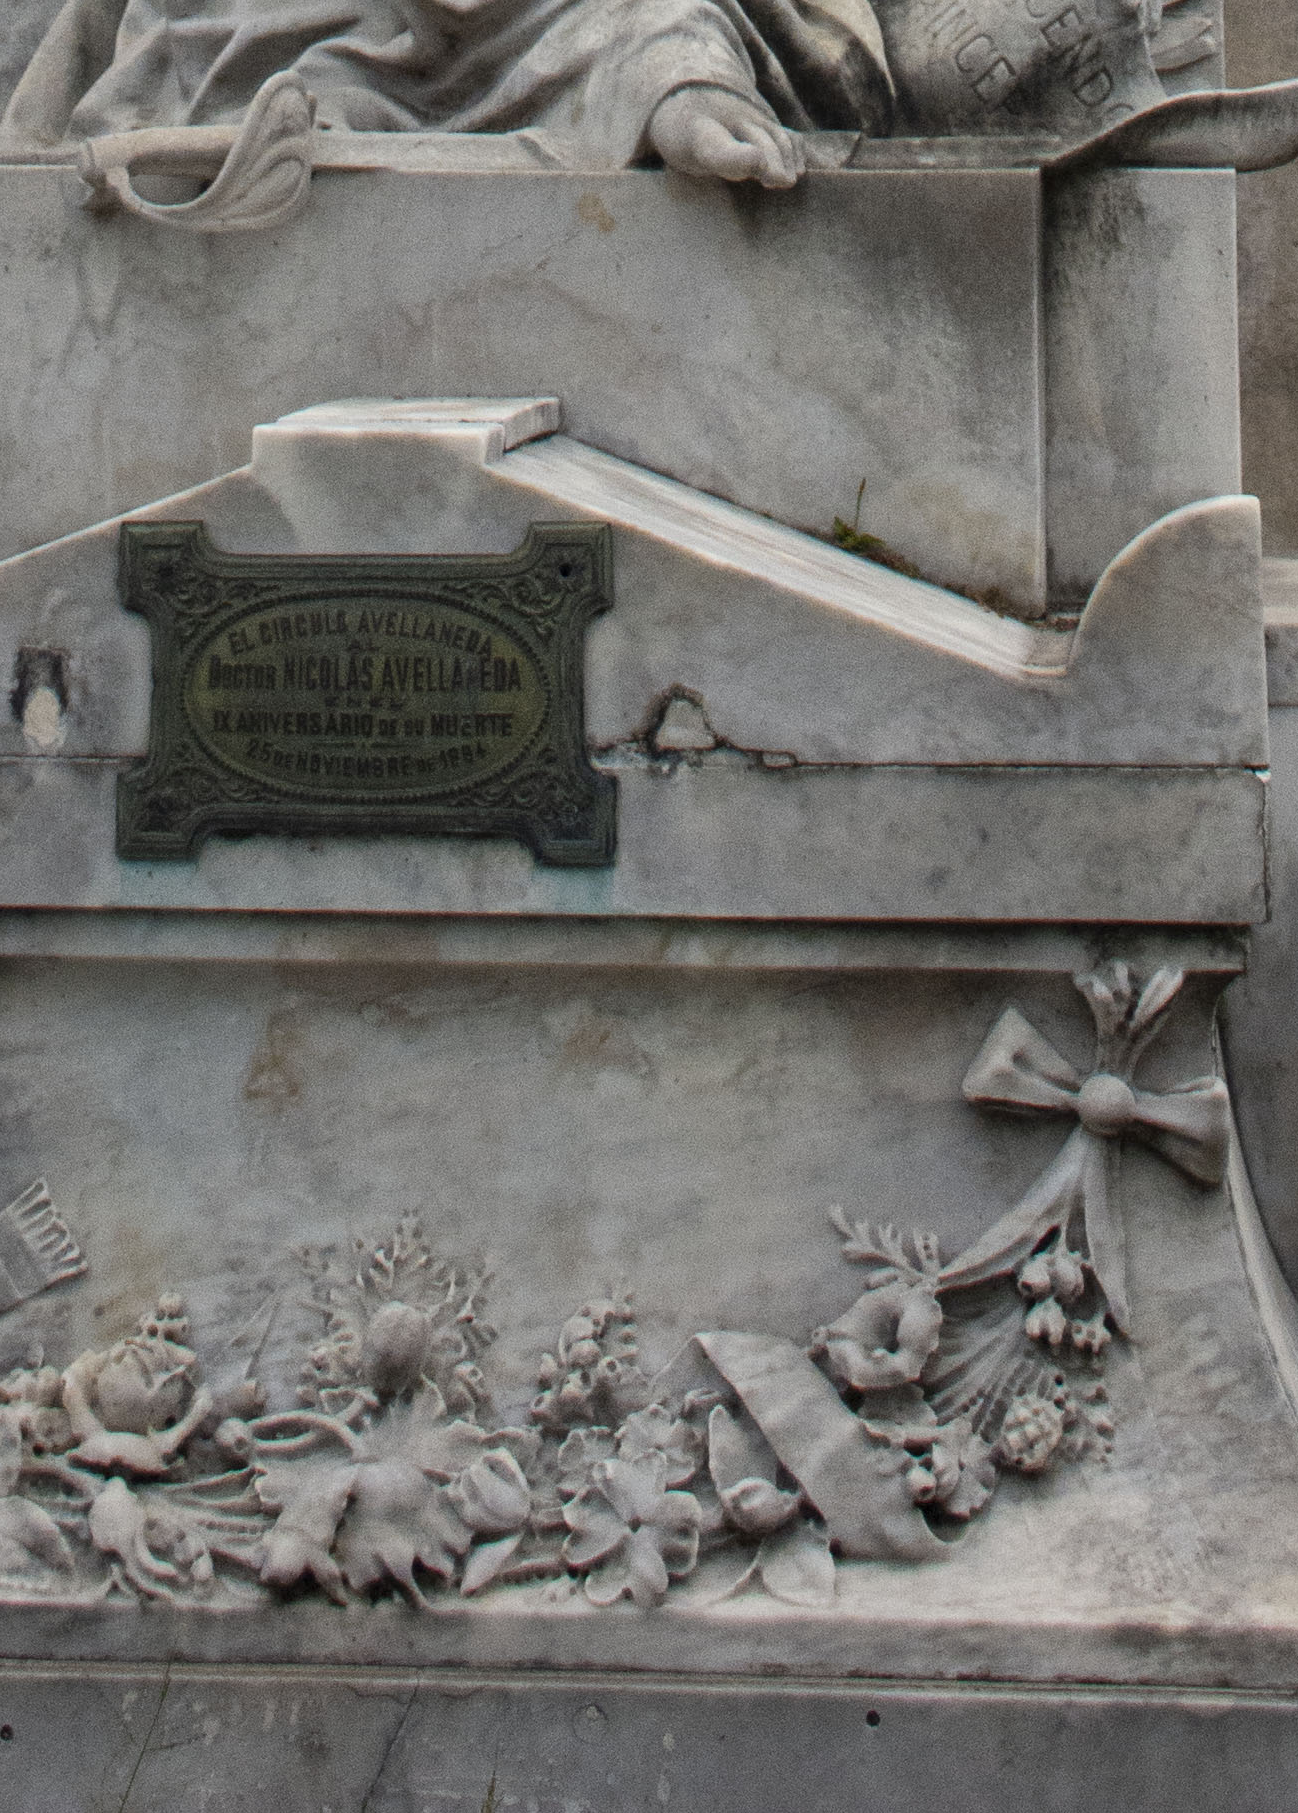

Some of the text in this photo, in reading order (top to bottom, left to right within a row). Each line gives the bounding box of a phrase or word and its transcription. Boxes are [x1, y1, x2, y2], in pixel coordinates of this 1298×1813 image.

[228, 627, 255, 656] EL
[358, 610, 492, 659] AVELLANEDA
[213, 710, 233, 733] IX
[236, 711, 373, 737] ANIVERSARIO
[379, 718, 398, 736] DE
[430, 712, 514, 737] MUERTE
[246, 738, 274, 762] 25
[273, 751, 295, 769] DE
[297, 751, 412, 779] NOVIEMBRE
